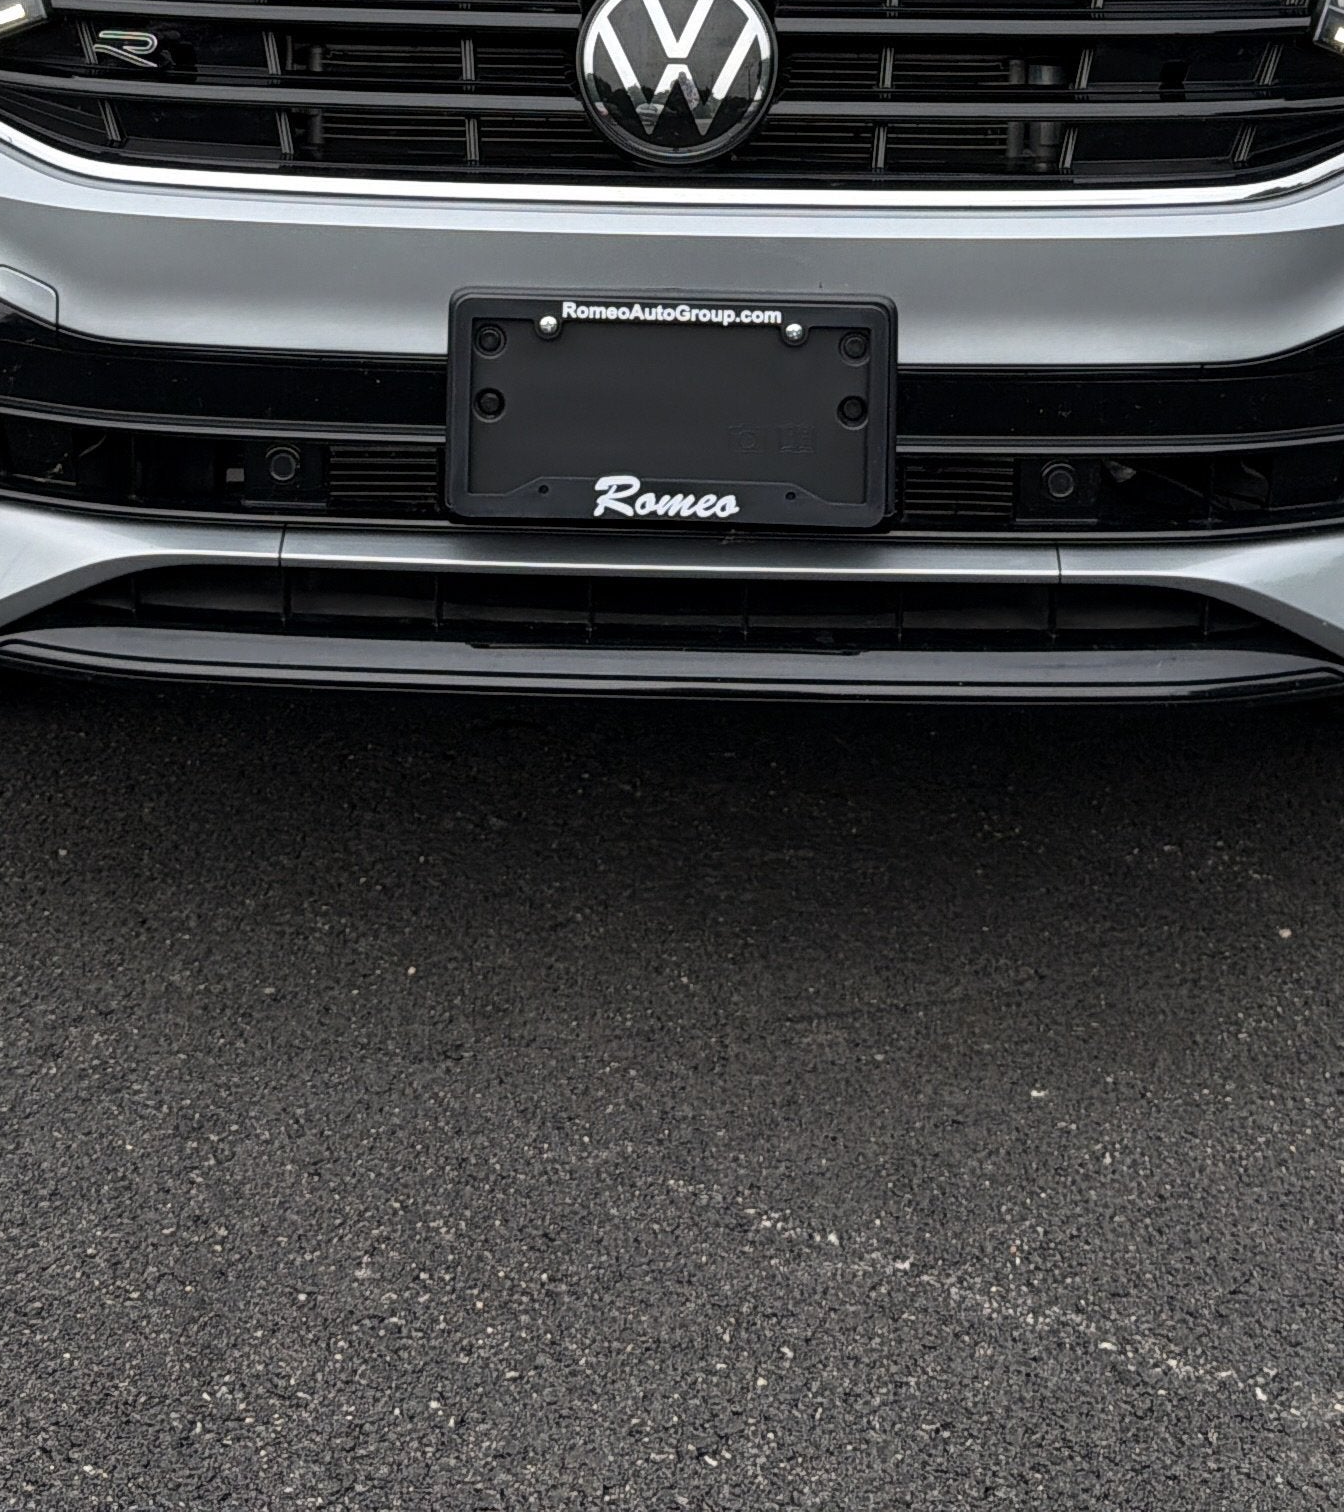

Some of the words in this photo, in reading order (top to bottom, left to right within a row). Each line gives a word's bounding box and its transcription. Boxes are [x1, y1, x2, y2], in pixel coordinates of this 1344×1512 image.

[92, 29, 159, 68] R
[561, 301, 782, 326] RomeoAutoGroup.com
[592, 474, 740, 518] Romeo
